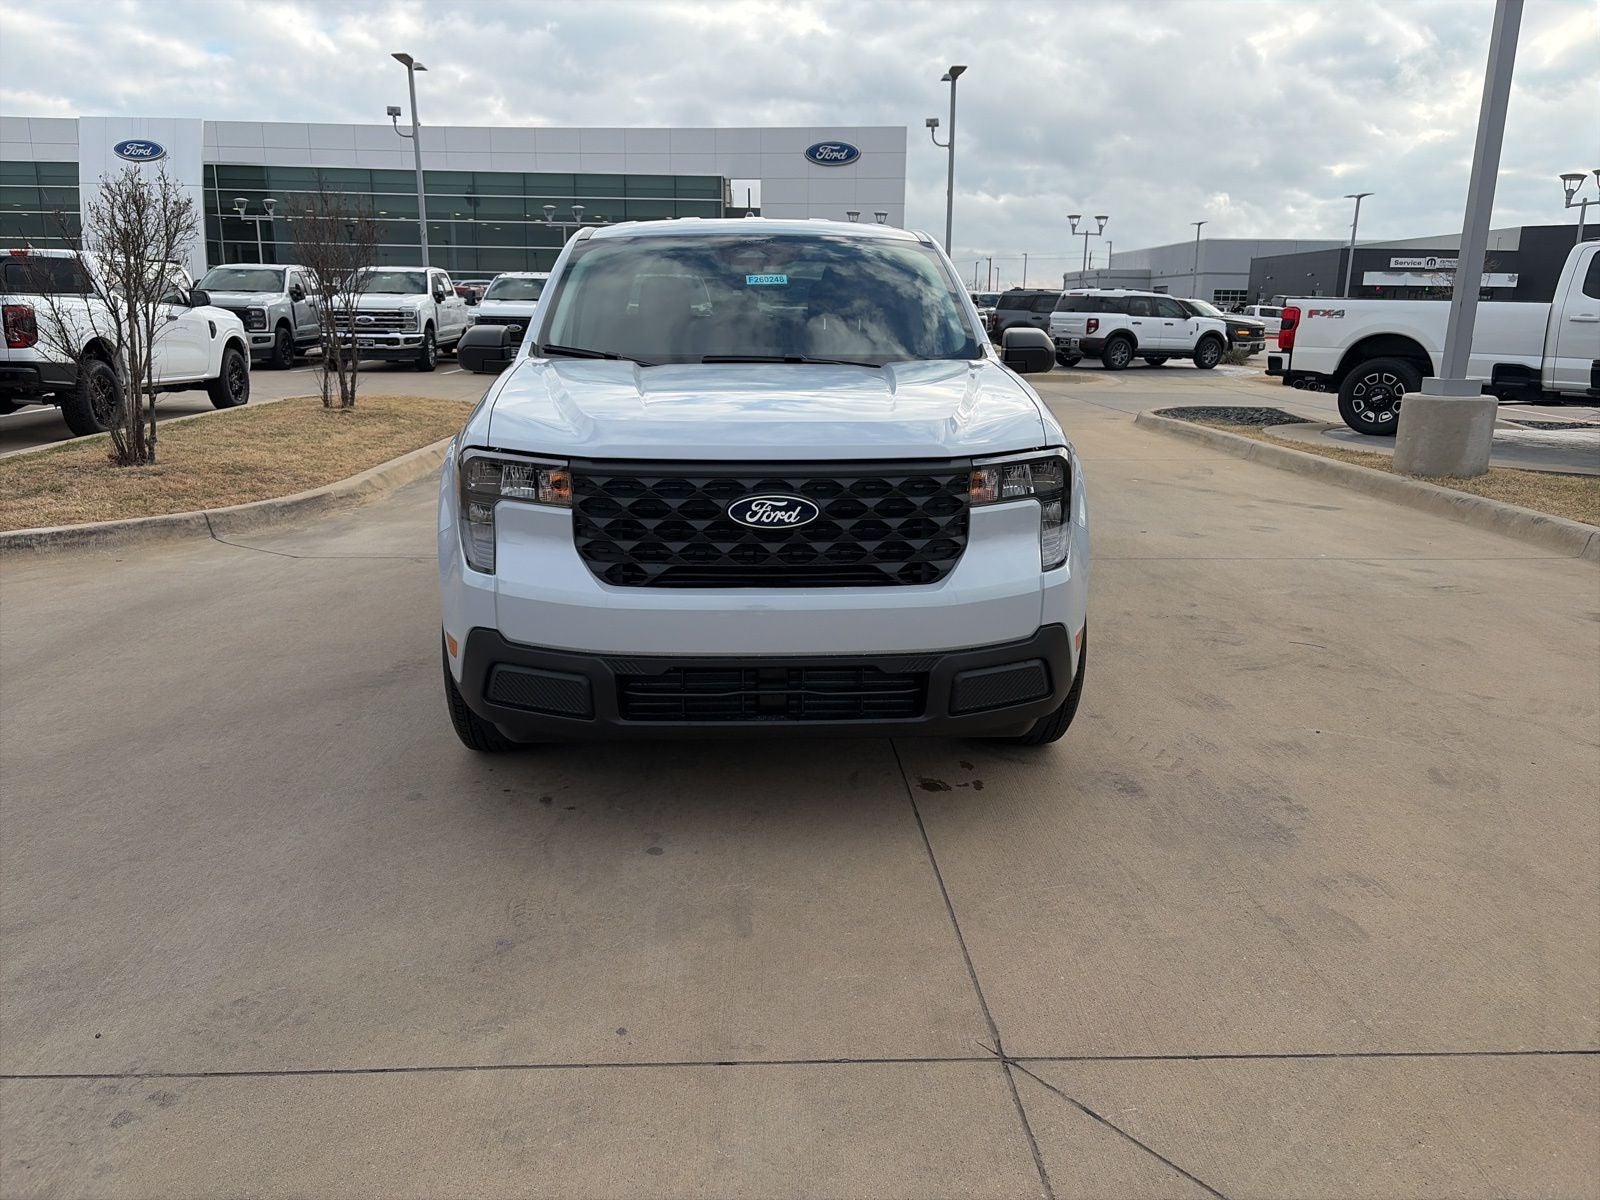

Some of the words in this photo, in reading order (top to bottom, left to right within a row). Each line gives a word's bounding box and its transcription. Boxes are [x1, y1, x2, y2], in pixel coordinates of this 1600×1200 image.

[123, 142, 153, 156] Ford
[815, 145, 848, 160] Ford
[1307, 309, 1345, 318] FX4
[745, 499, 802, 523] Ford
